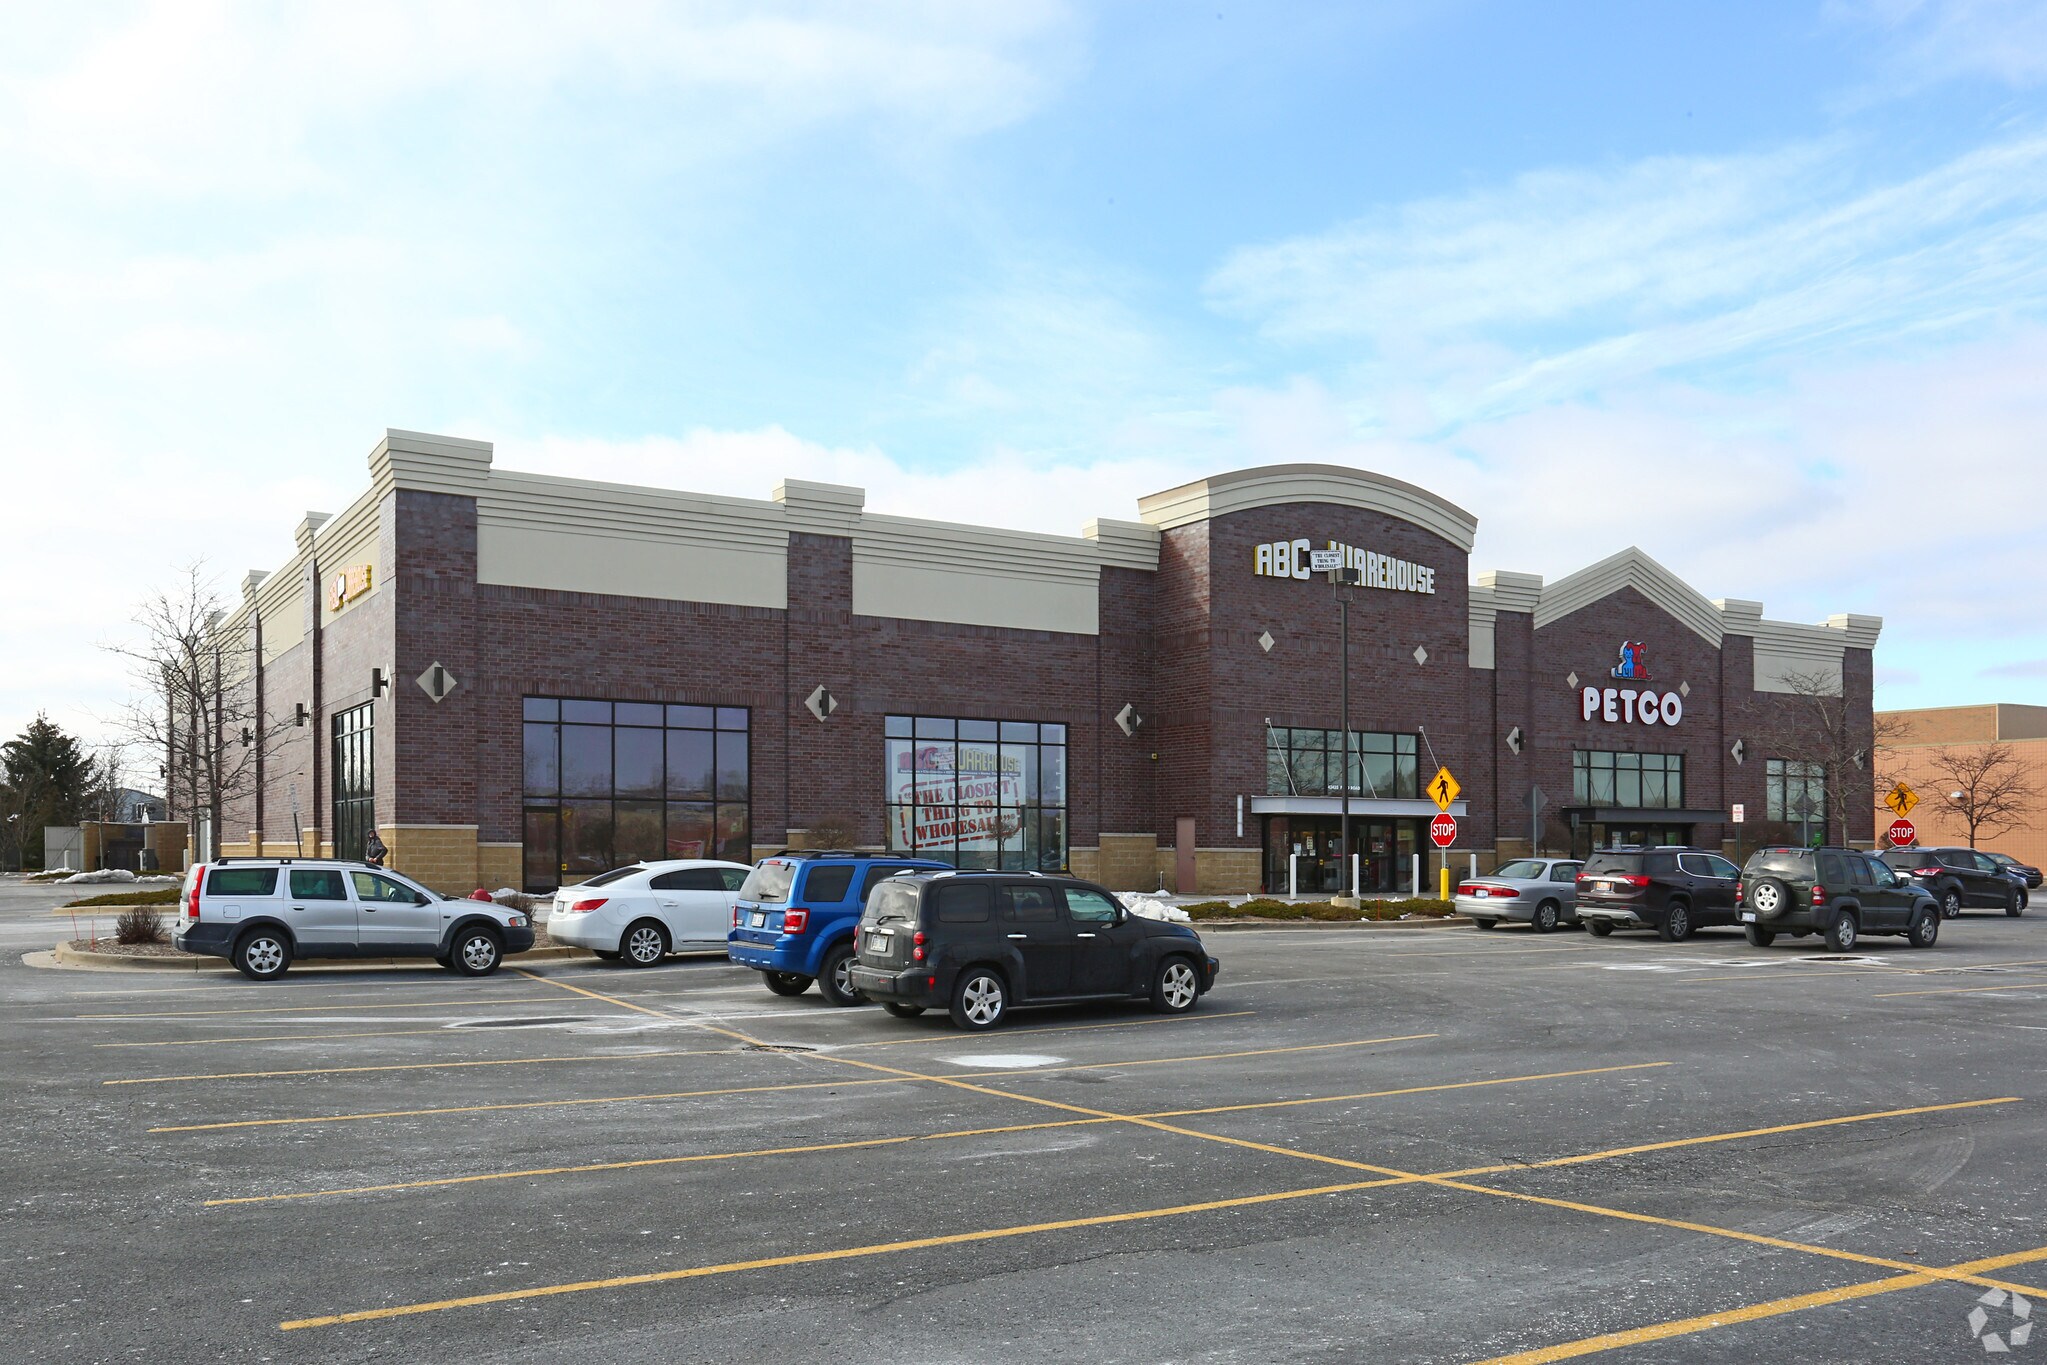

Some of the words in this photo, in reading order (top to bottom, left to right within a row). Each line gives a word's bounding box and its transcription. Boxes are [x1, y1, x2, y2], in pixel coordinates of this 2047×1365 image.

[1255, 538, 1311, 581] ABC
[1581, 686, 1683, 727] PETCO
[947, 780, 1010, 801] CLOSEST
[922, 802, 970, 822] THING
[974, 799, 994, 816] TO
[1432, 823, 1455, 836] STOP
[1890, 827, 1914, 838] STOP
